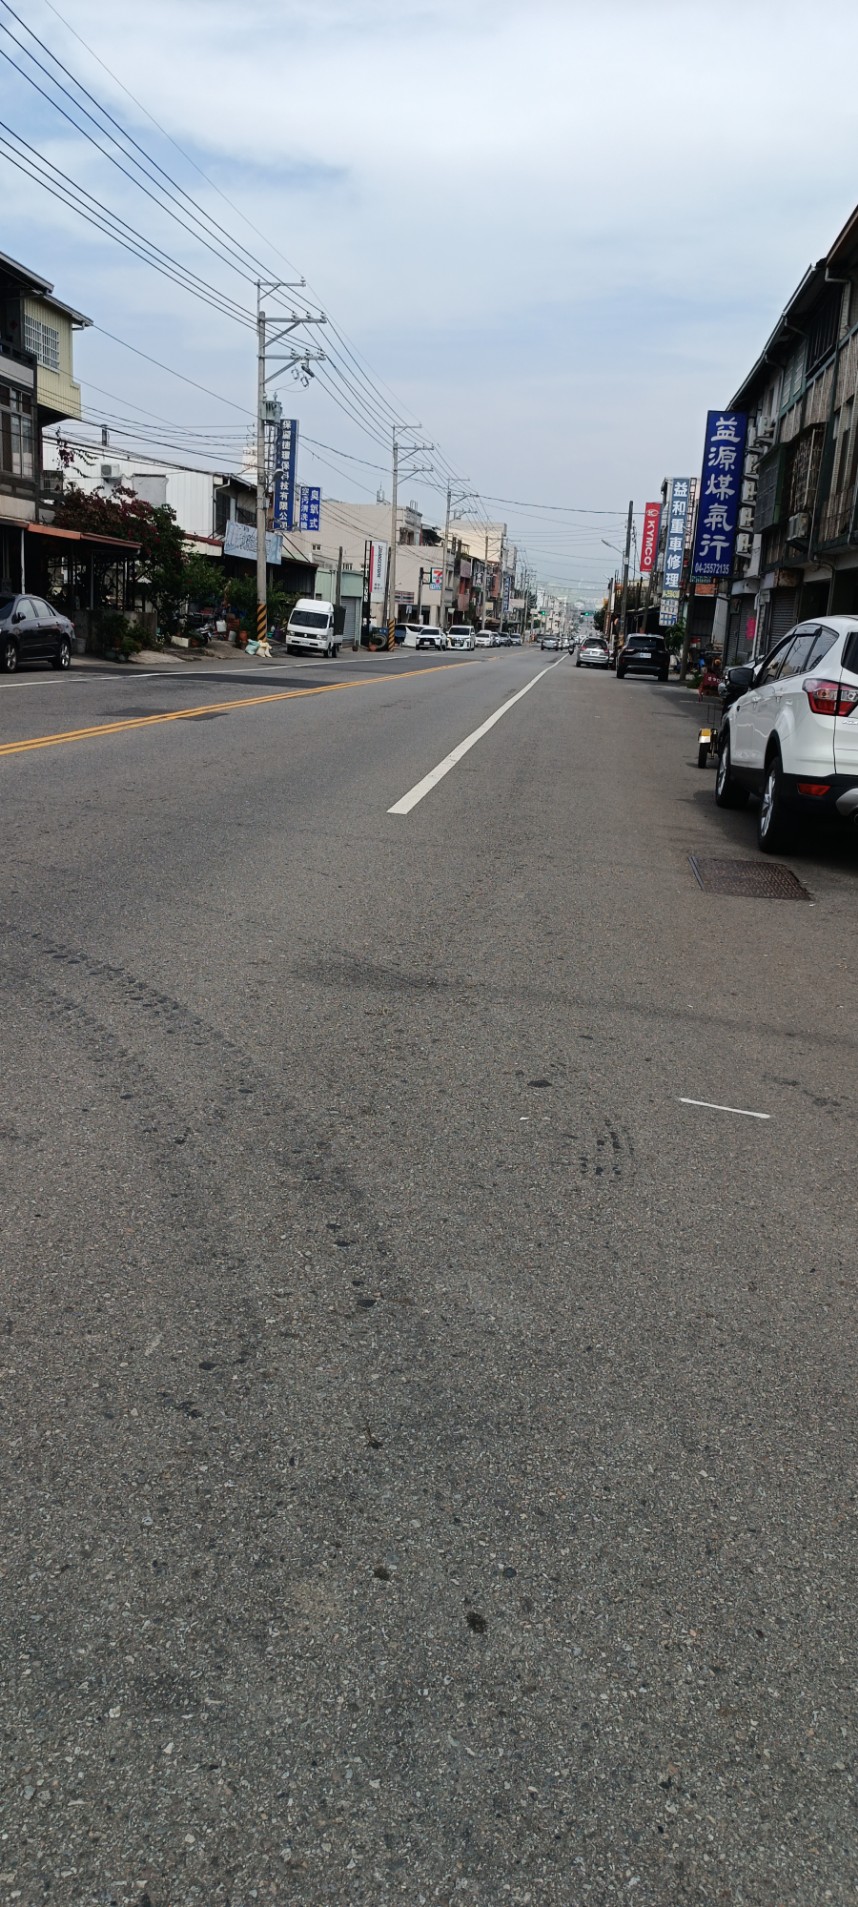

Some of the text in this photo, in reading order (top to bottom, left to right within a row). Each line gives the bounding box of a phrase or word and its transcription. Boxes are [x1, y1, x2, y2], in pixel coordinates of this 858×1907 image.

[699, 416, 741, 561] 益源煤氣行
[643, 520, 656, 566] KYMCO
[665, 482, 688, 588] 益和重車修理
[694, 562, 730, 575] 04-25572135
